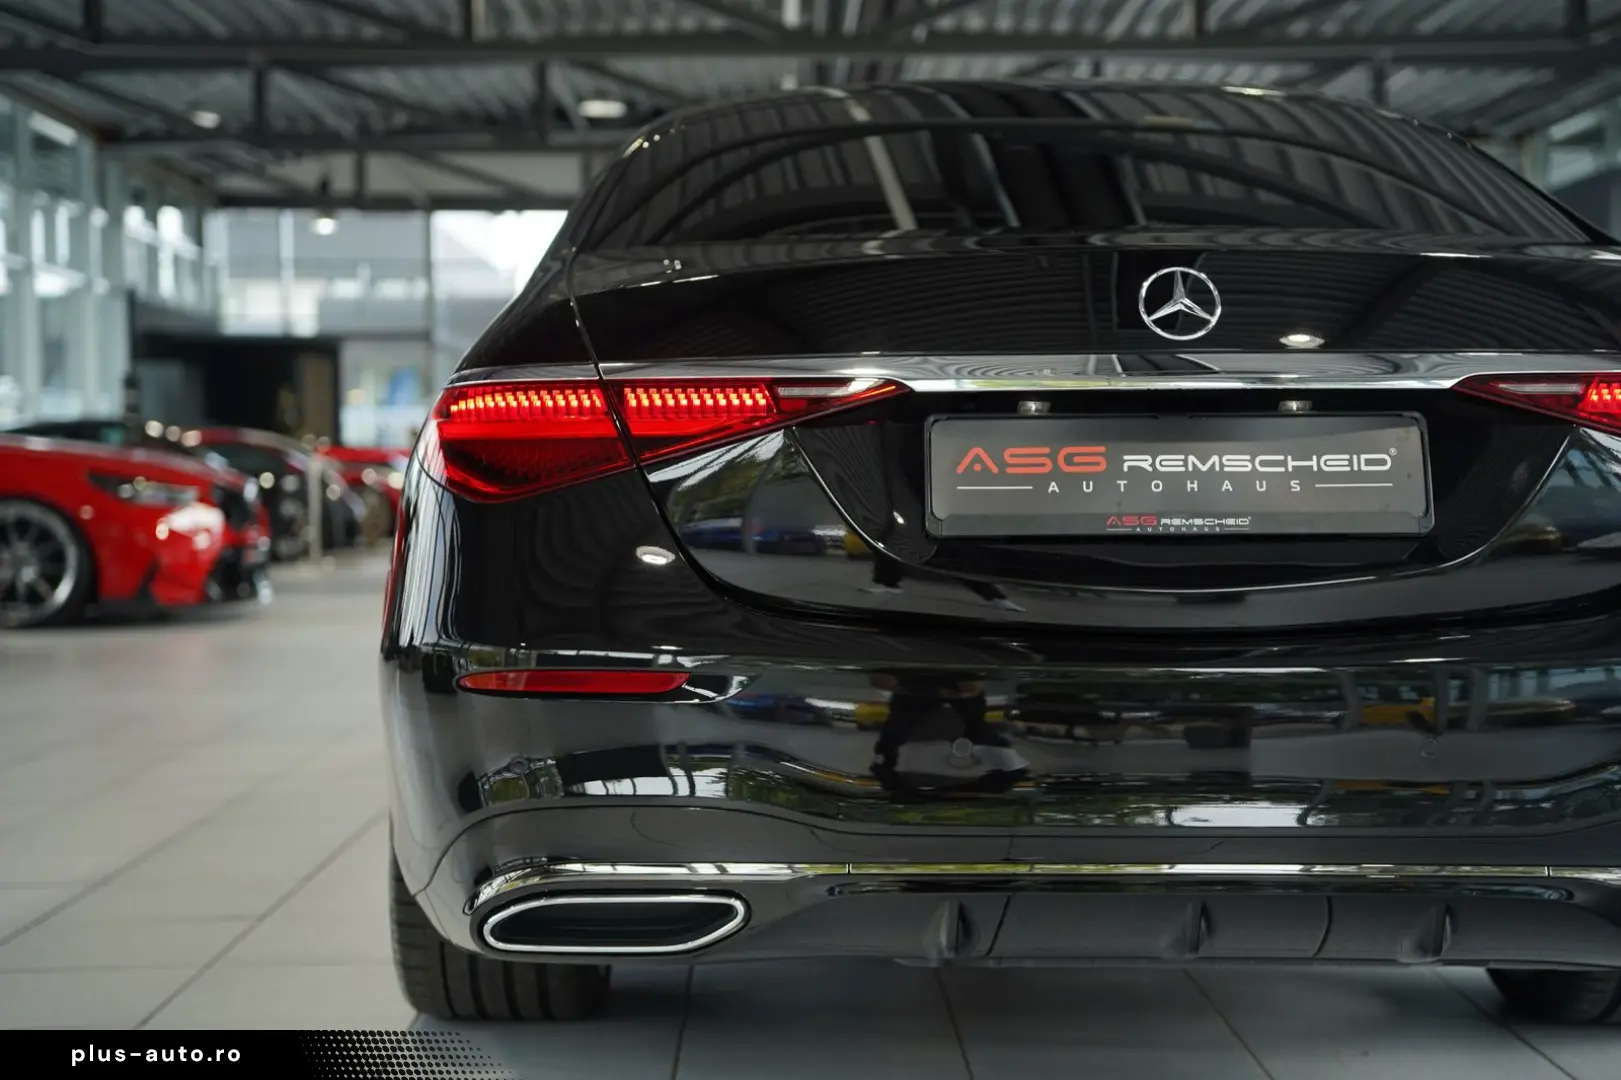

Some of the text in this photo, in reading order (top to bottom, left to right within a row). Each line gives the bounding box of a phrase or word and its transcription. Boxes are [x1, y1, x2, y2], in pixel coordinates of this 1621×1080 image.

[957, 446, 1107, 474] ASG
[1047, 480, 1302, 494] AUTOHAUS
[1106, 515, 1157, 525] ASG
